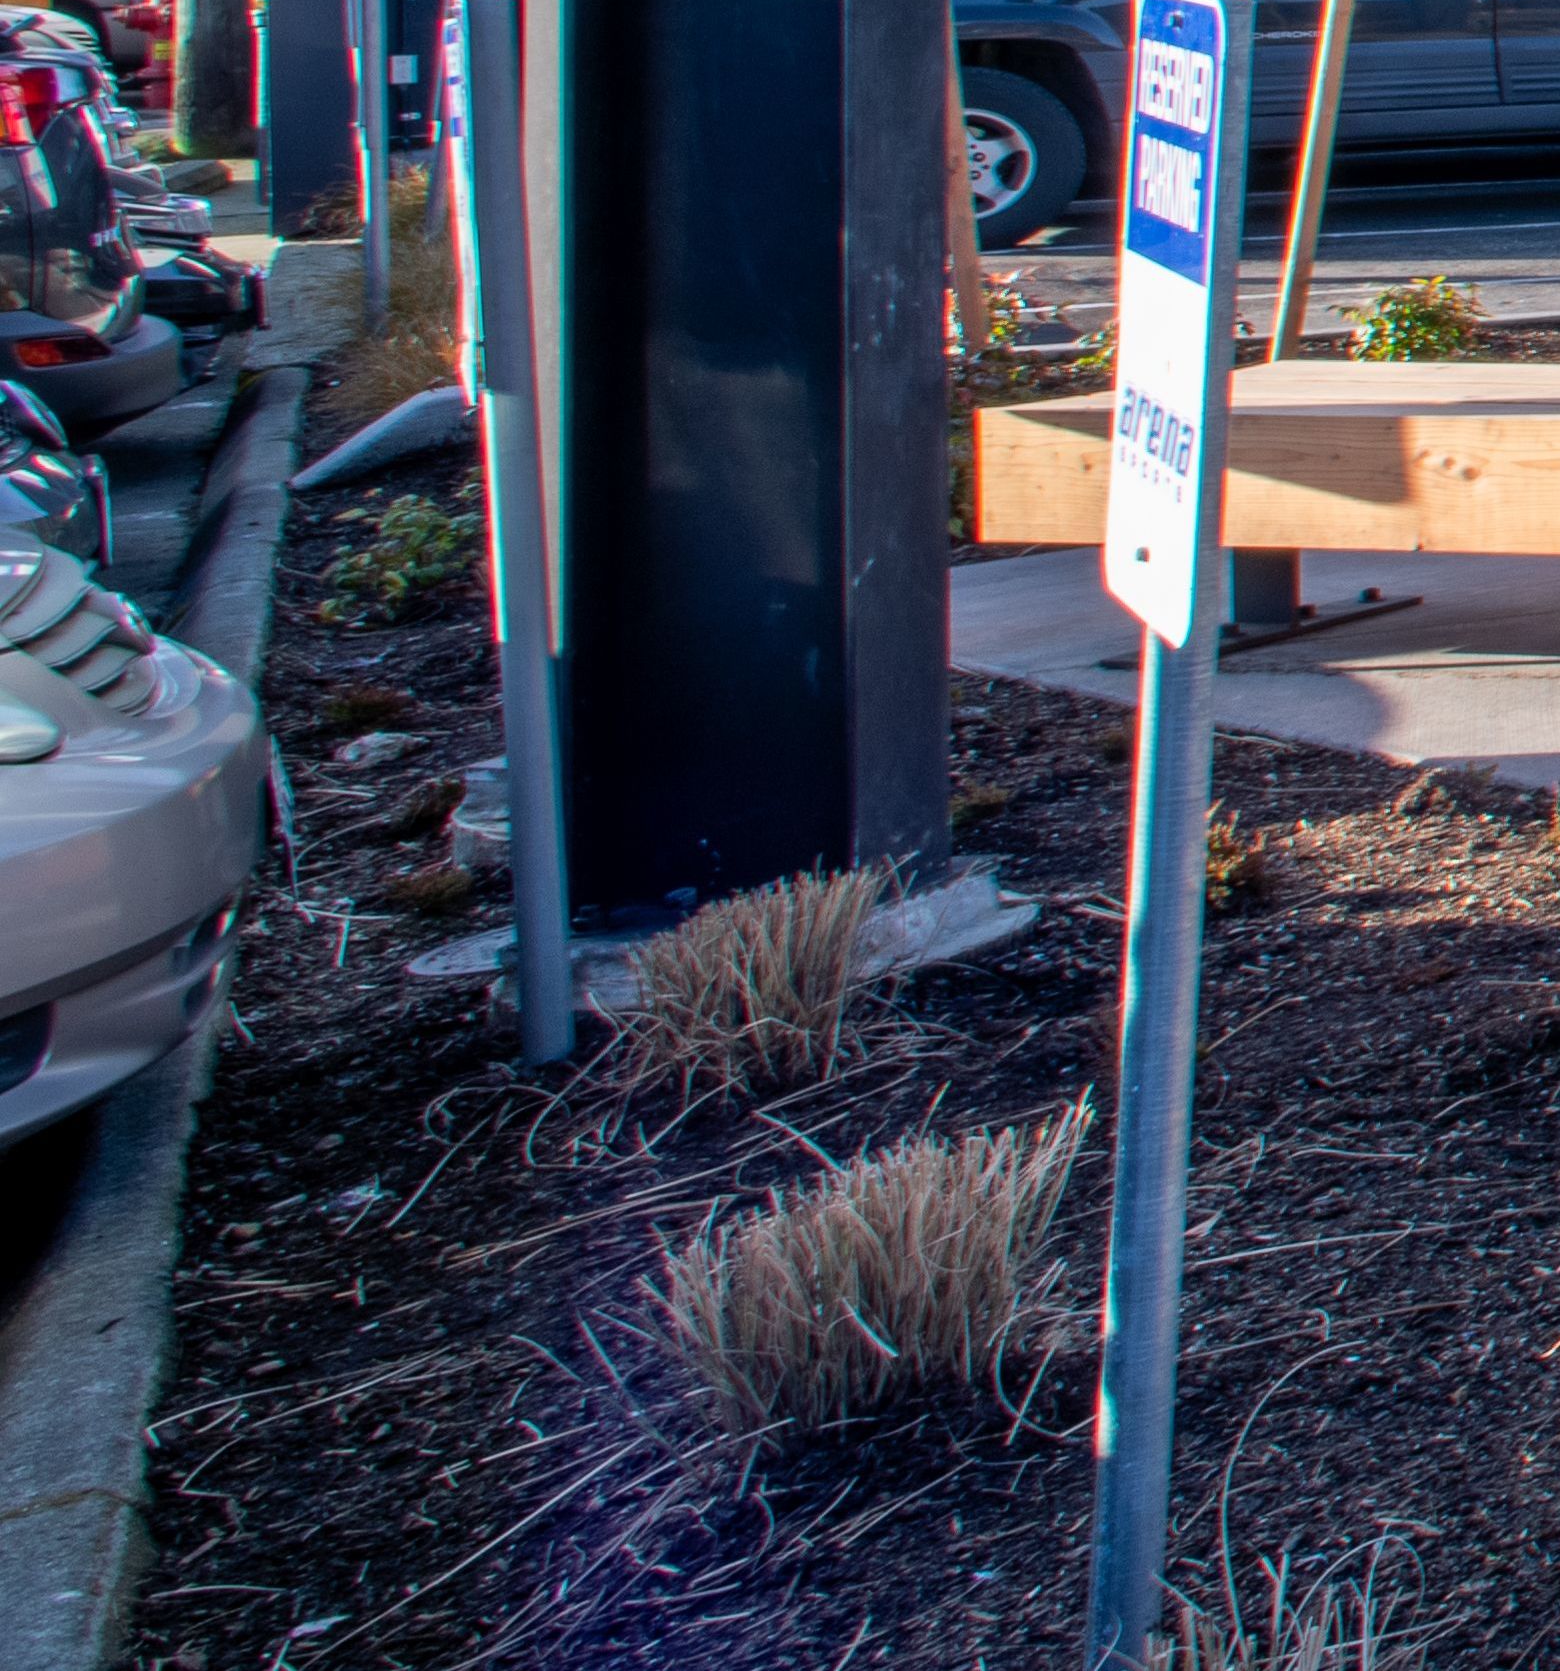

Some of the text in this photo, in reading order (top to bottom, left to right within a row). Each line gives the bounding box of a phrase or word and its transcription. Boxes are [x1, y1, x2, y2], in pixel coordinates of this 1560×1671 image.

[1137, 38, 1214, 134] RESERVED
[1135, 133, 1202, 233] PARKING
[1119, 386, 1194, 478] arena
